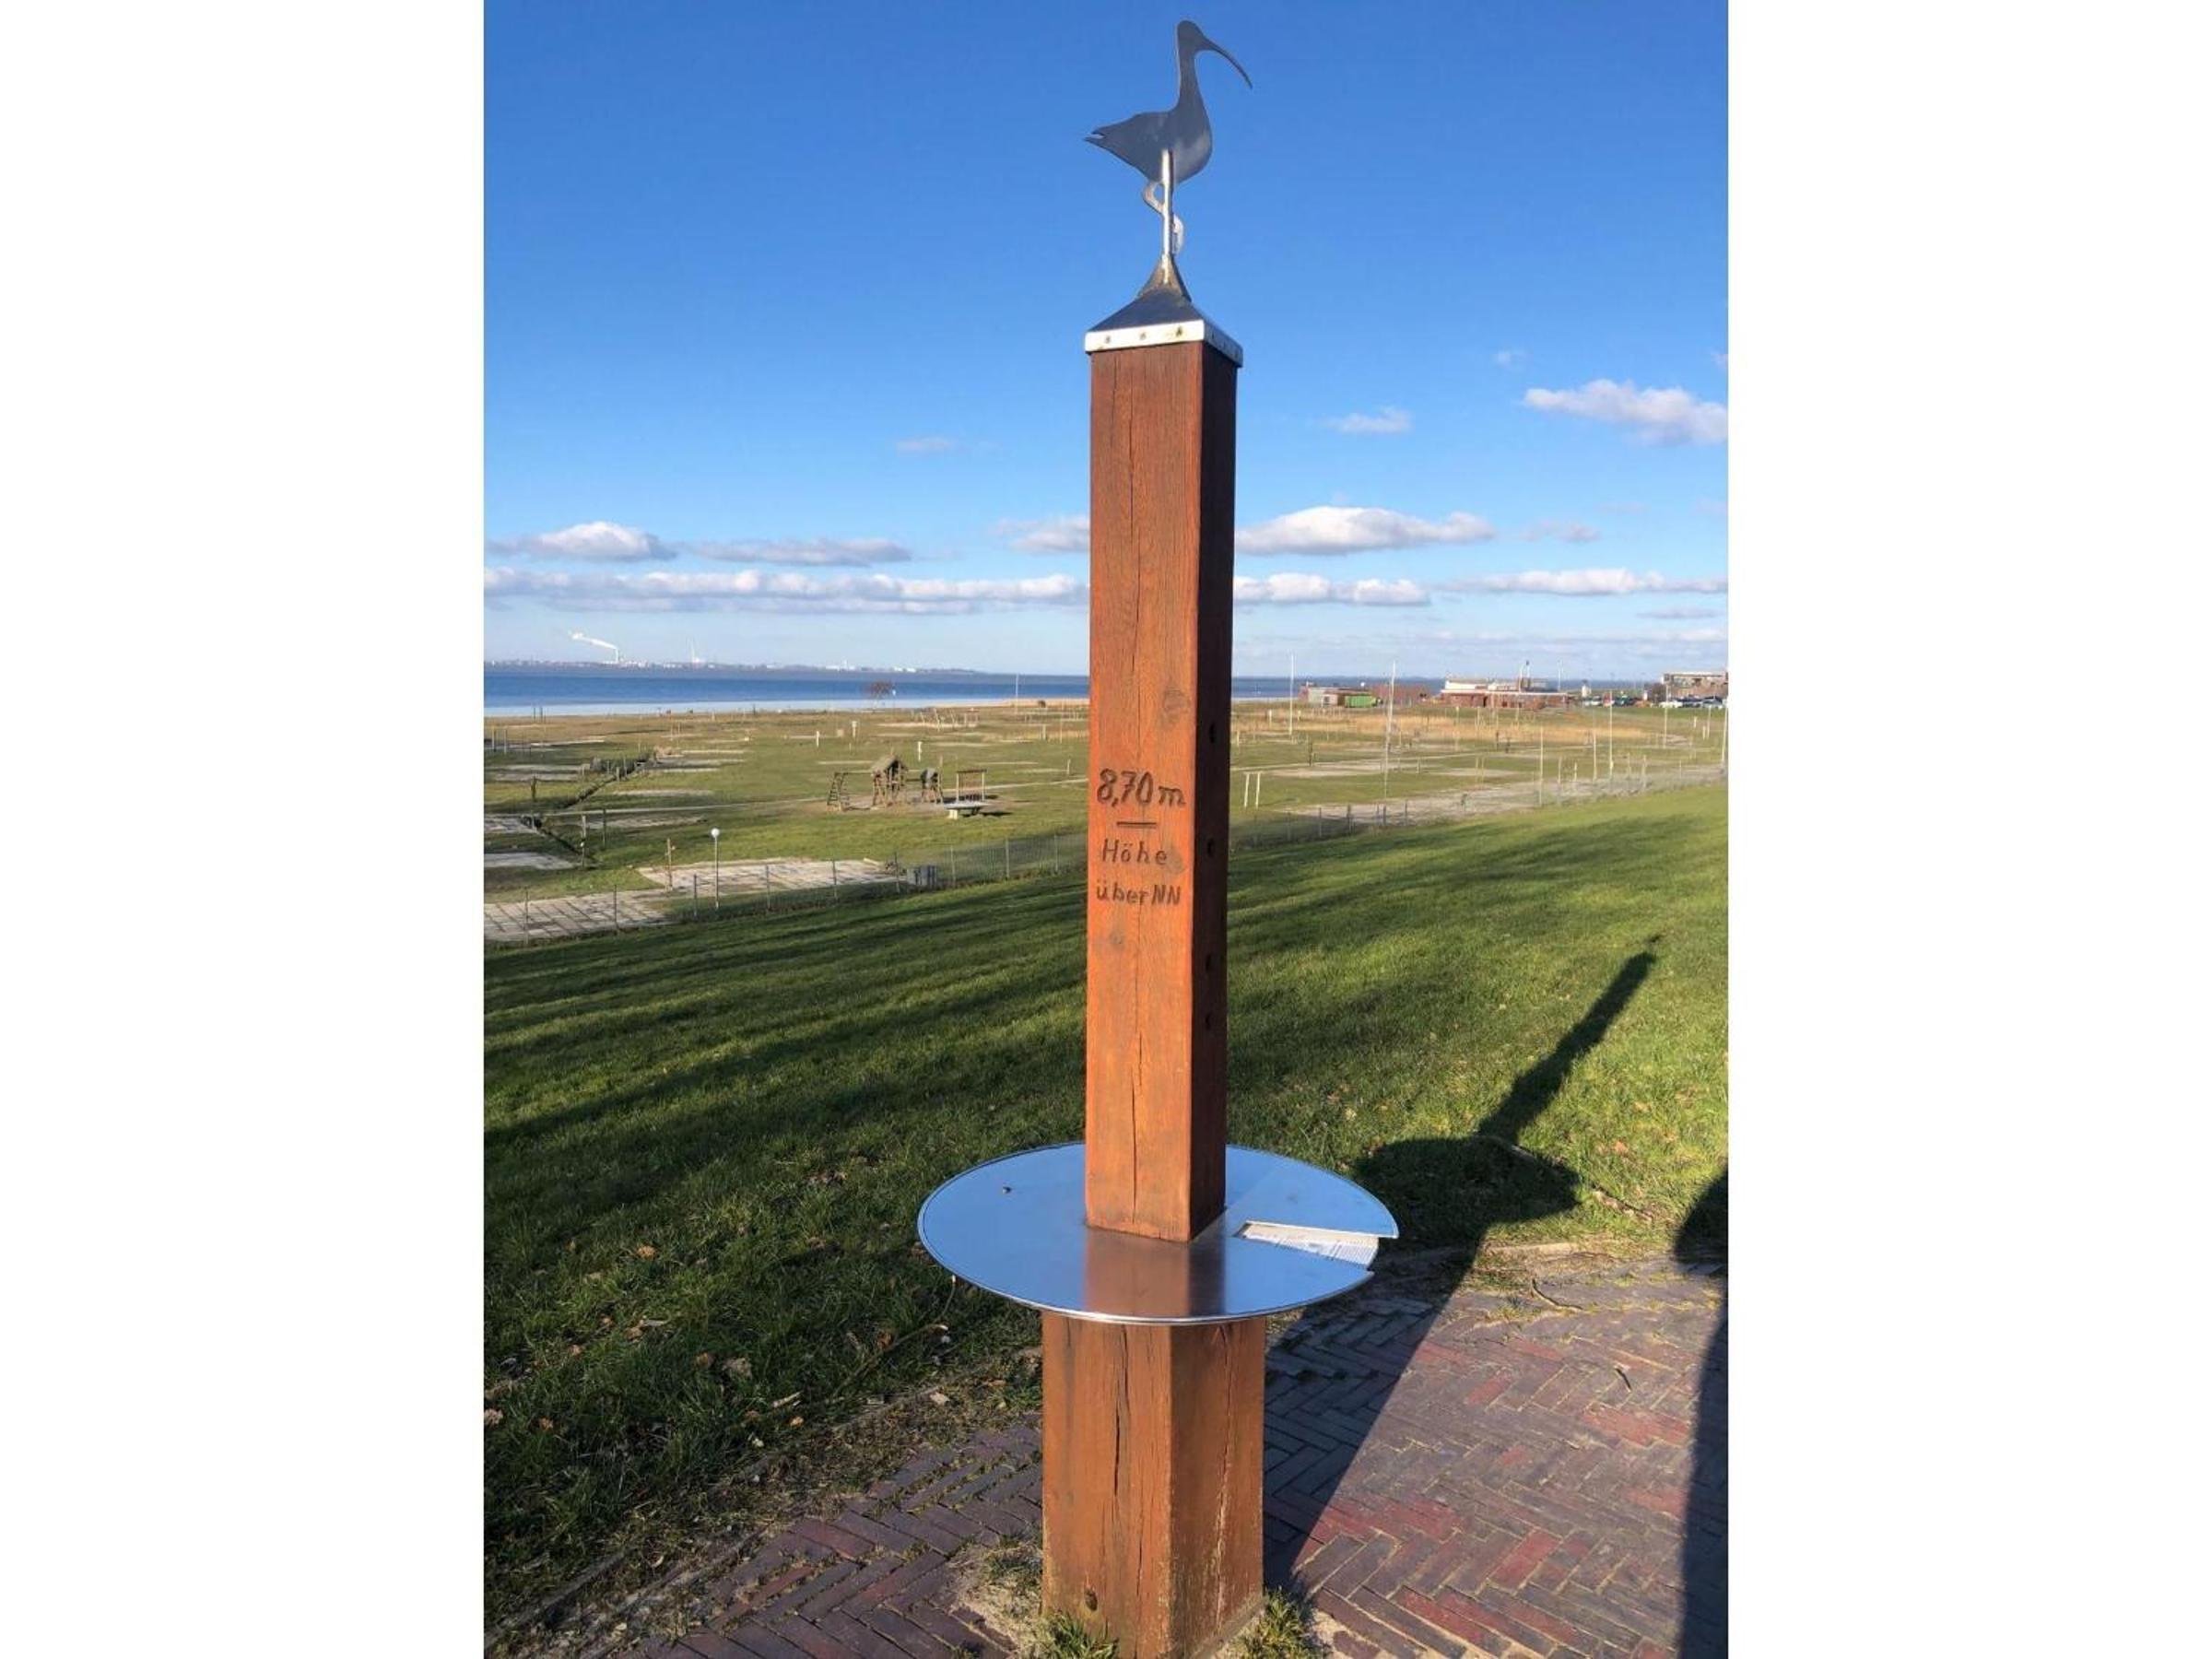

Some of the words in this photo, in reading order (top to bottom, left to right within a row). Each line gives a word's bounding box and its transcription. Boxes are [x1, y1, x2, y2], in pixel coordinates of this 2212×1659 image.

[1097, 768, 1153, 807] 8,70
[1158, 785, 1186, 807] m
[1102, 839, 1167, 865] Höhe
[1096, 878, 1148, 906] über
[1152, 884, 1181, 906] NN
